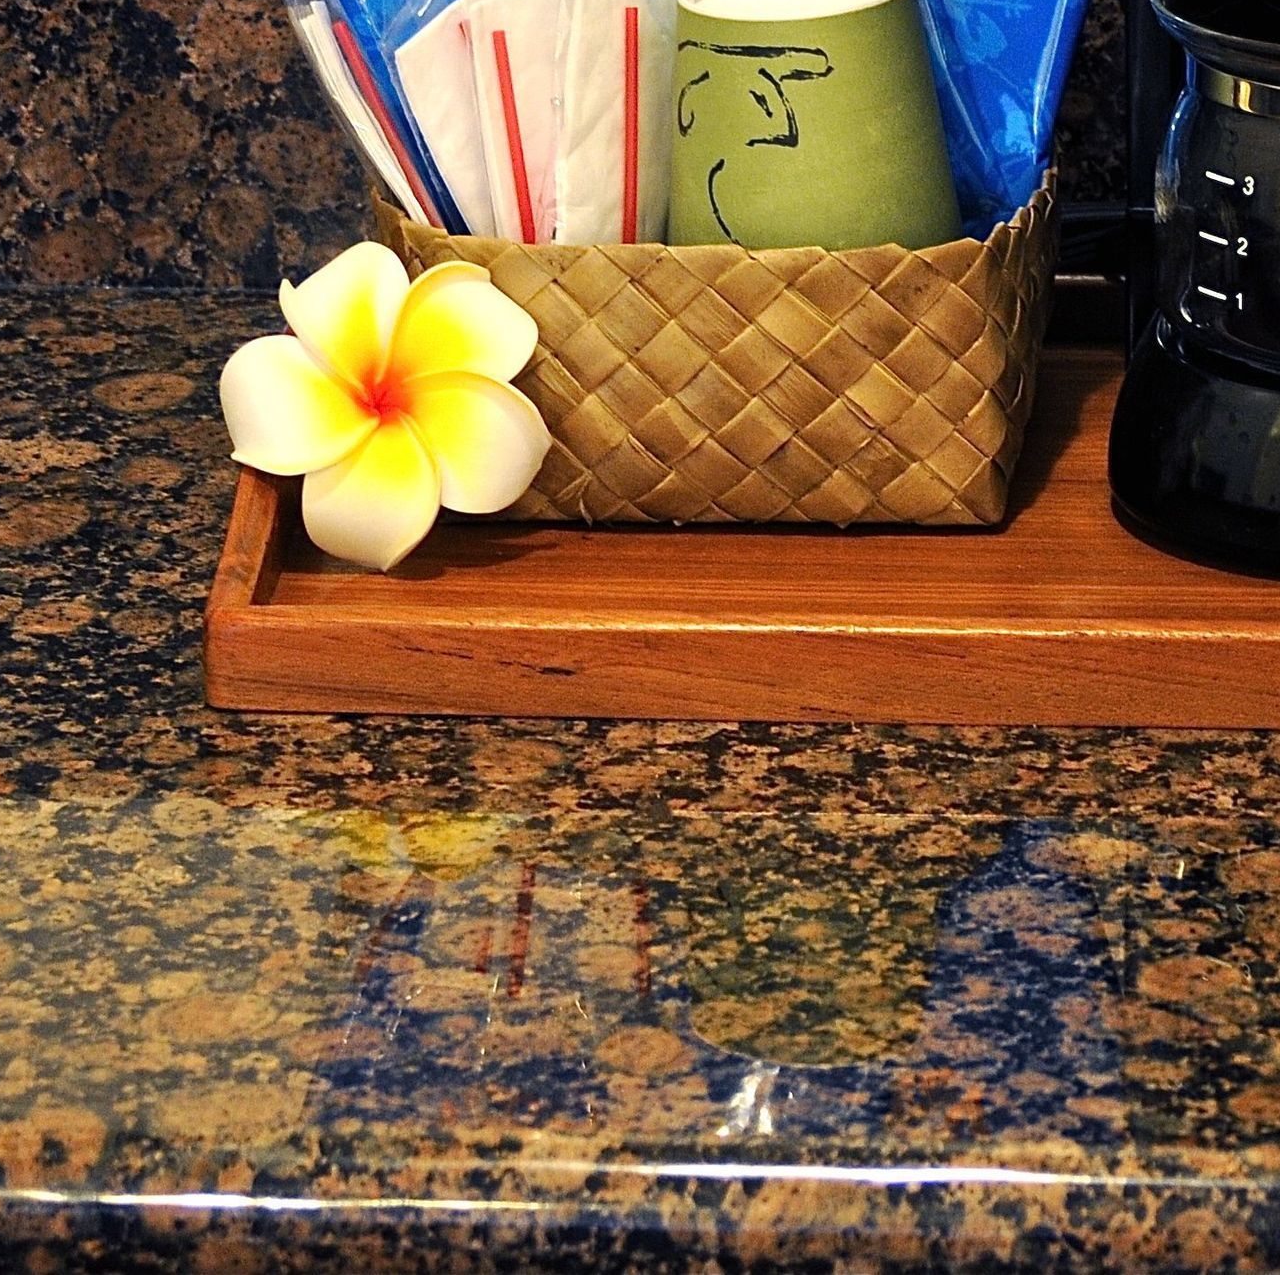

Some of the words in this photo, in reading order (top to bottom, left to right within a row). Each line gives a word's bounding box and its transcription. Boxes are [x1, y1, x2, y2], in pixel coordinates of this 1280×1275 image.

[1242, 175, 1254, 195] 3
[1236, 236, 1248, 257] 2
[1235, 292, 1244, 310] 1
